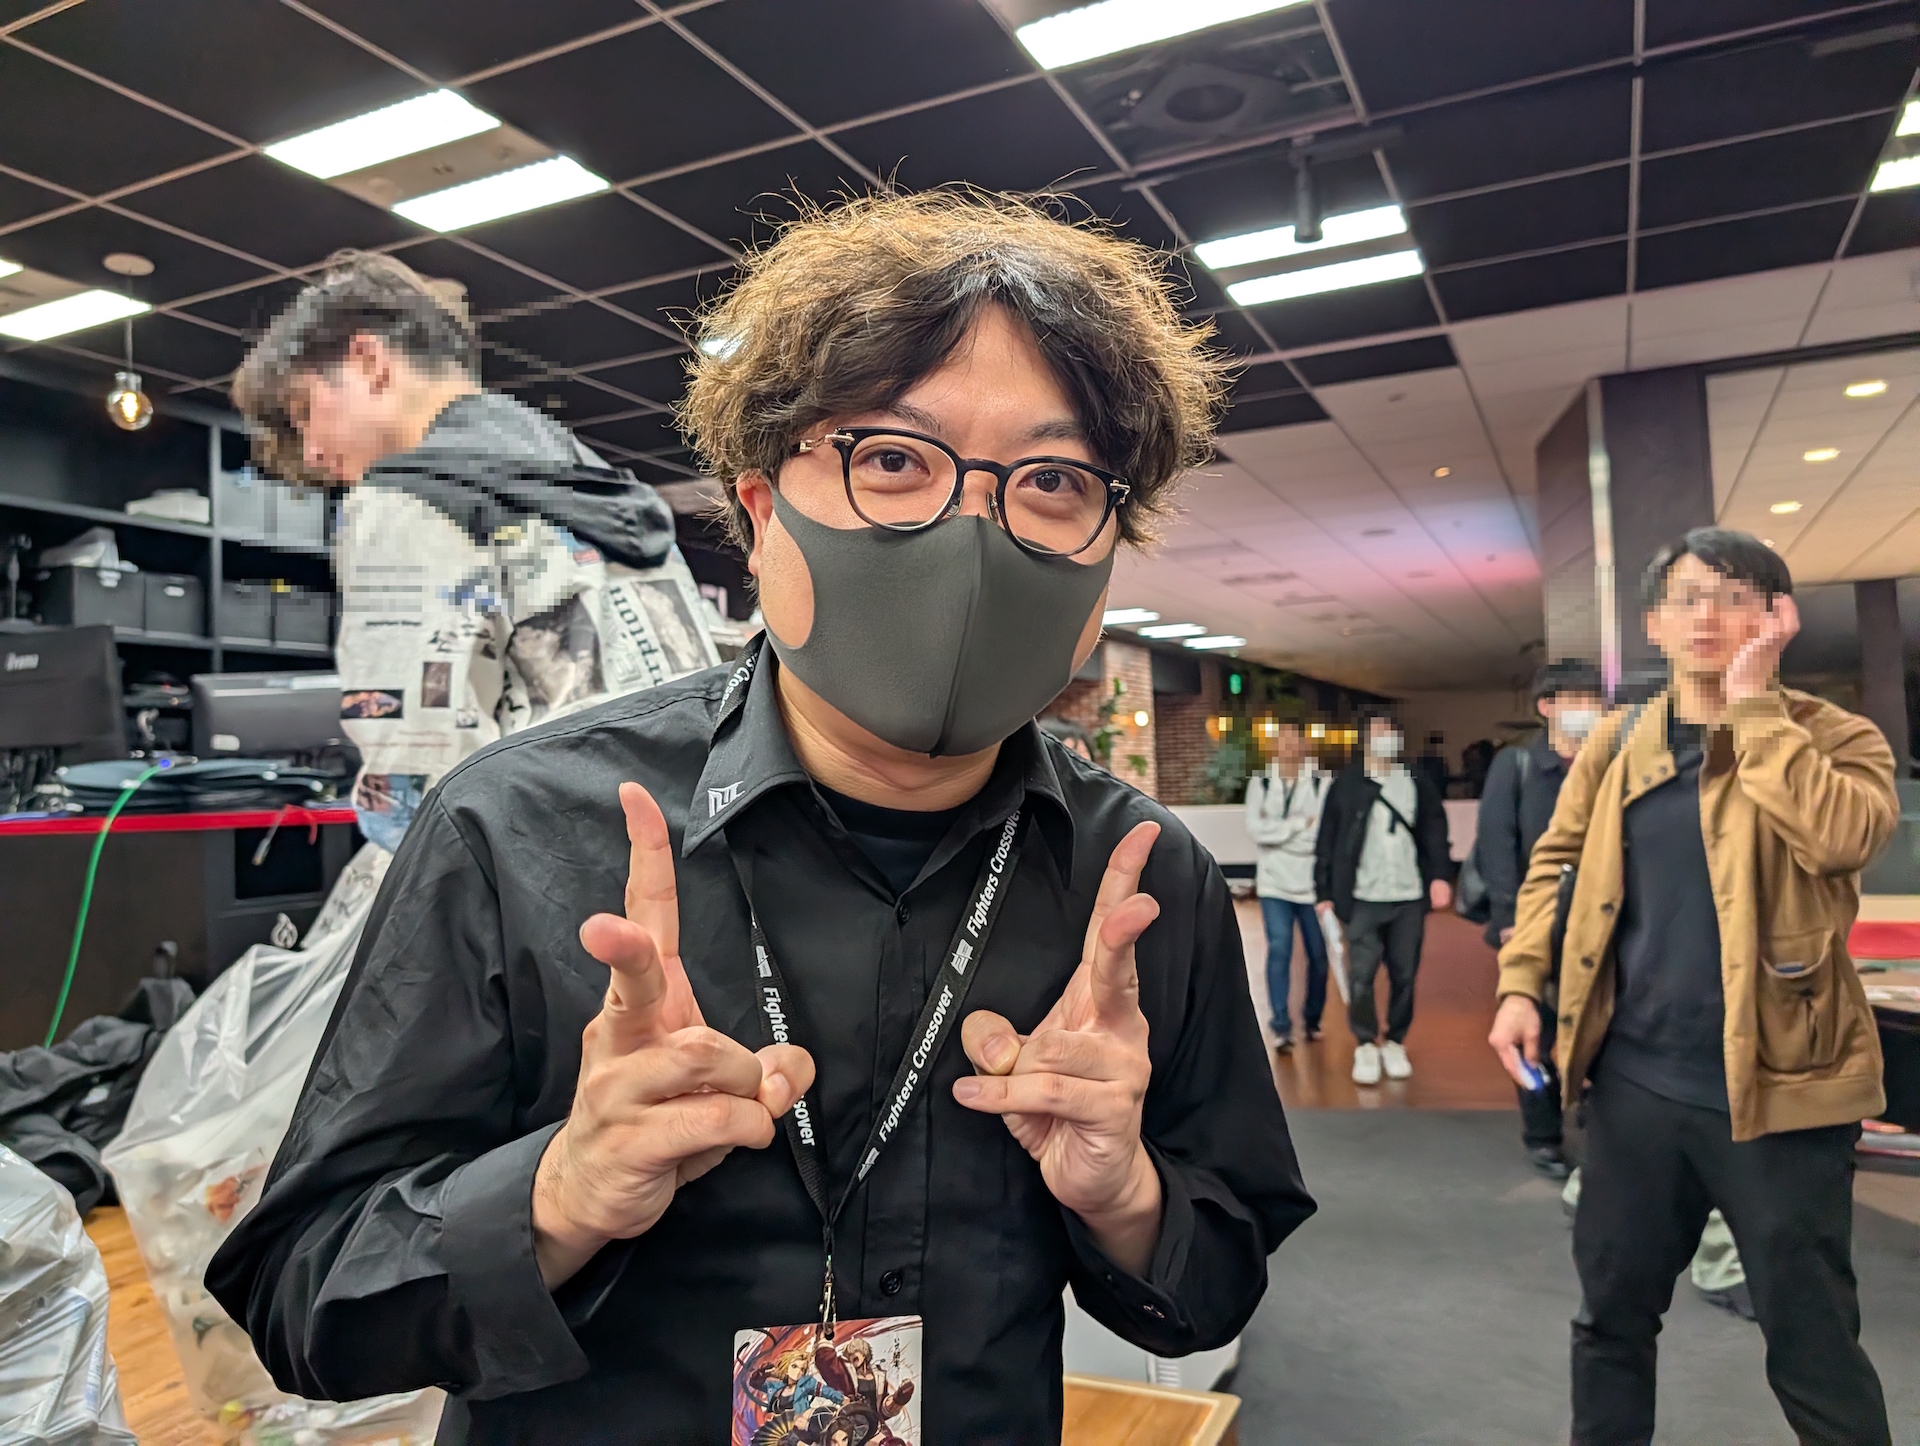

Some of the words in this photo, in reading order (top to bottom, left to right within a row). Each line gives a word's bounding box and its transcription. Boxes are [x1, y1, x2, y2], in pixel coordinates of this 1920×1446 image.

[966, 873, 999, 938] Fighters
[763, 987, 791, 1045] Fighte
[793, 1095, 816, 1146] sover
[878, 1069, 919, 1142] Fighters
[912, 984, 955, 1069] Crossover
